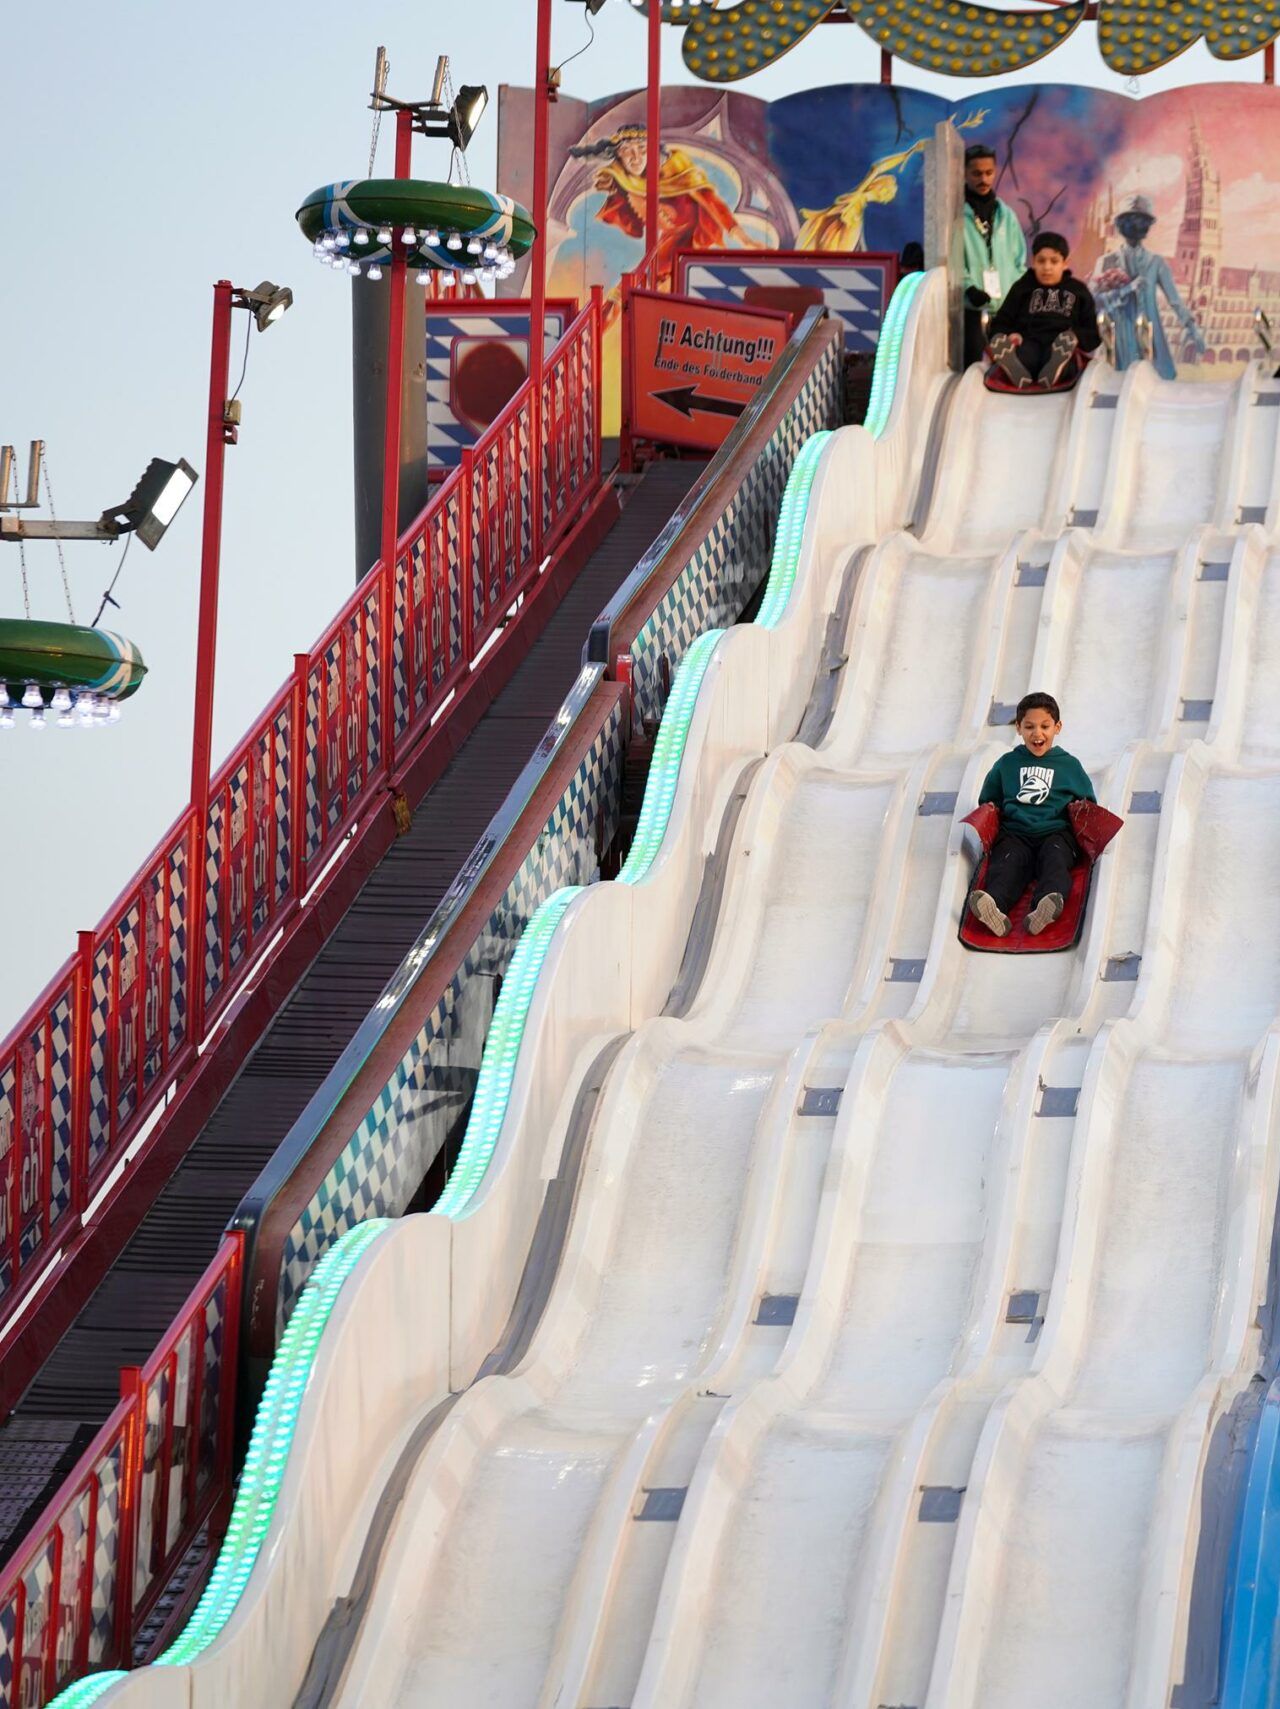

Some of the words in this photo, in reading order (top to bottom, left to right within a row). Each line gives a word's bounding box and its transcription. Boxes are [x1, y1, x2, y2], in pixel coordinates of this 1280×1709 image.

[1028, 288, 1077, 317] GAP
[680, 324, 774, 364] Achtung!!!
[654, 355, 680, 371] Ende
[682, 360, 701, 375] des
[1019, 765, 1055, 790] PUMA
